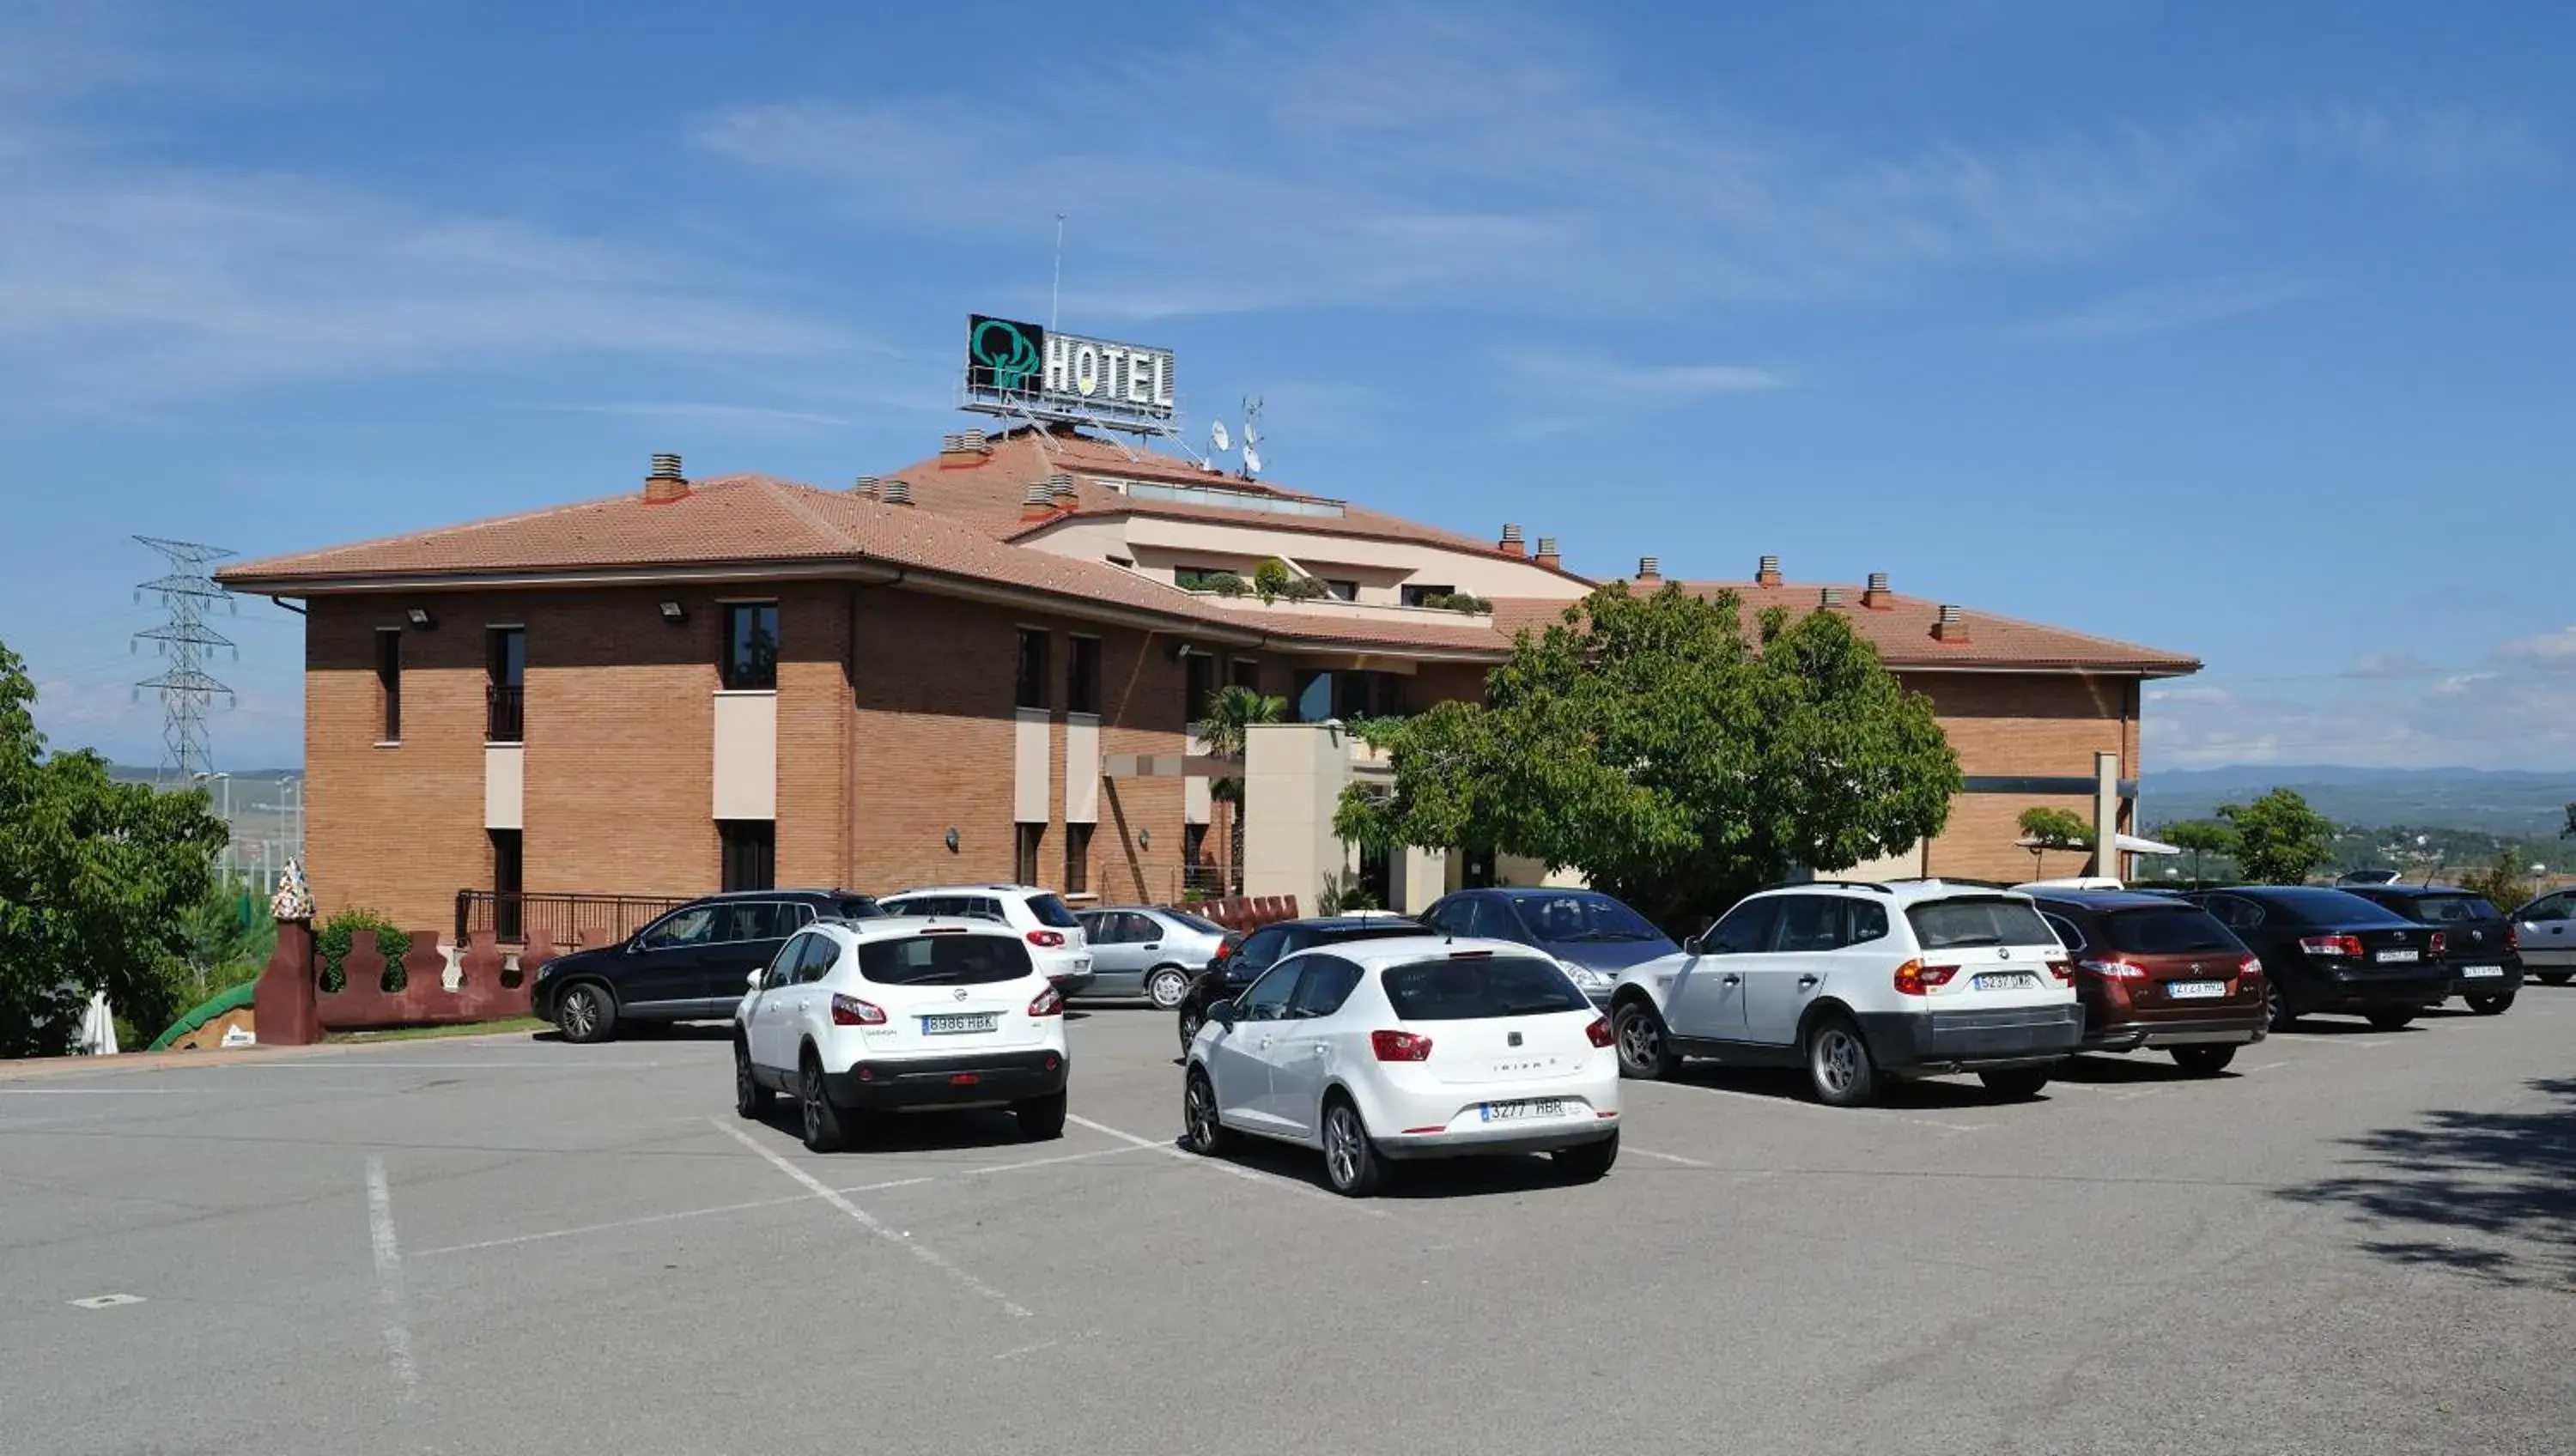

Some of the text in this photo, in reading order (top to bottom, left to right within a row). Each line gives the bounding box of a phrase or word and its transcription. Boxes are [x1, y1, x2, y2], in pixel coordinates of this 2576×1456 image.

[1045, 338, 1173, 406] HOTEL
[930, 1015, 992, 1030] 8986 HBK
[1492, 1098, 1563, 1118] 3277 HBR
